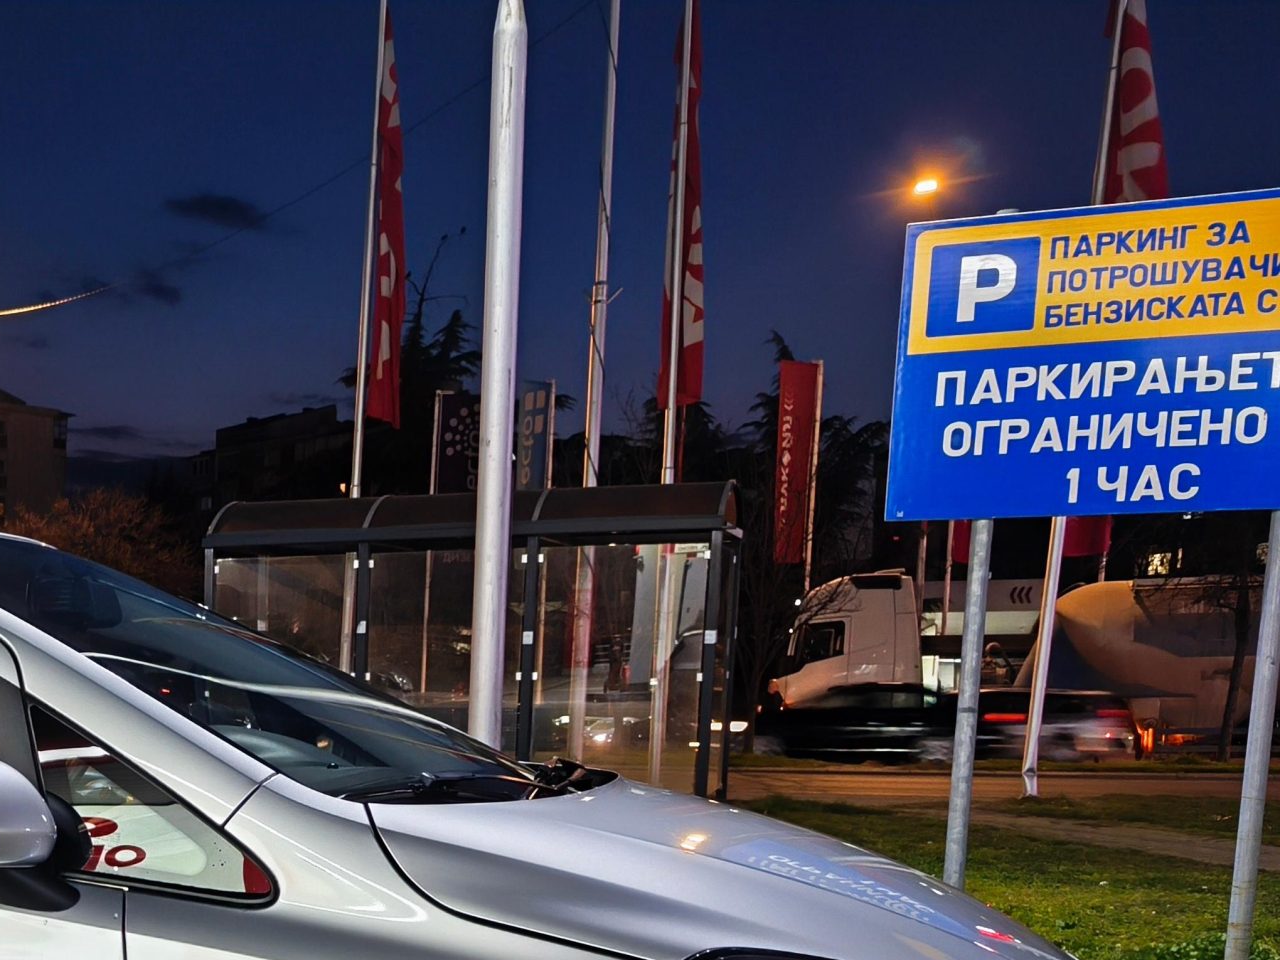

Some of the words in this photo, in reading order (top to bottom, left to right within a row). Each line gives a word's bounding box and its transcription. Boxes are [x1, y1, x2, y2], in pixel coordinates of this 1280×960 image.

[1050, 225, 1197, 259] ПАРКИНГ
[1206, 220, 1250, 247] ЗА
[956, 253, 1018, 323] P
[1044, 292, 1244, 328] БЕНЗИСКАТА
[1257, 288, 1278, 313] С
[935, 351, 1280, 407] ПАРКИРАЊЕТ
[942, 406, 1268, 457] ОГРАНИЧЕНО
[1065, 467, 1081, 504] 1
[1097, 462, 1201, 502] ЧАС
